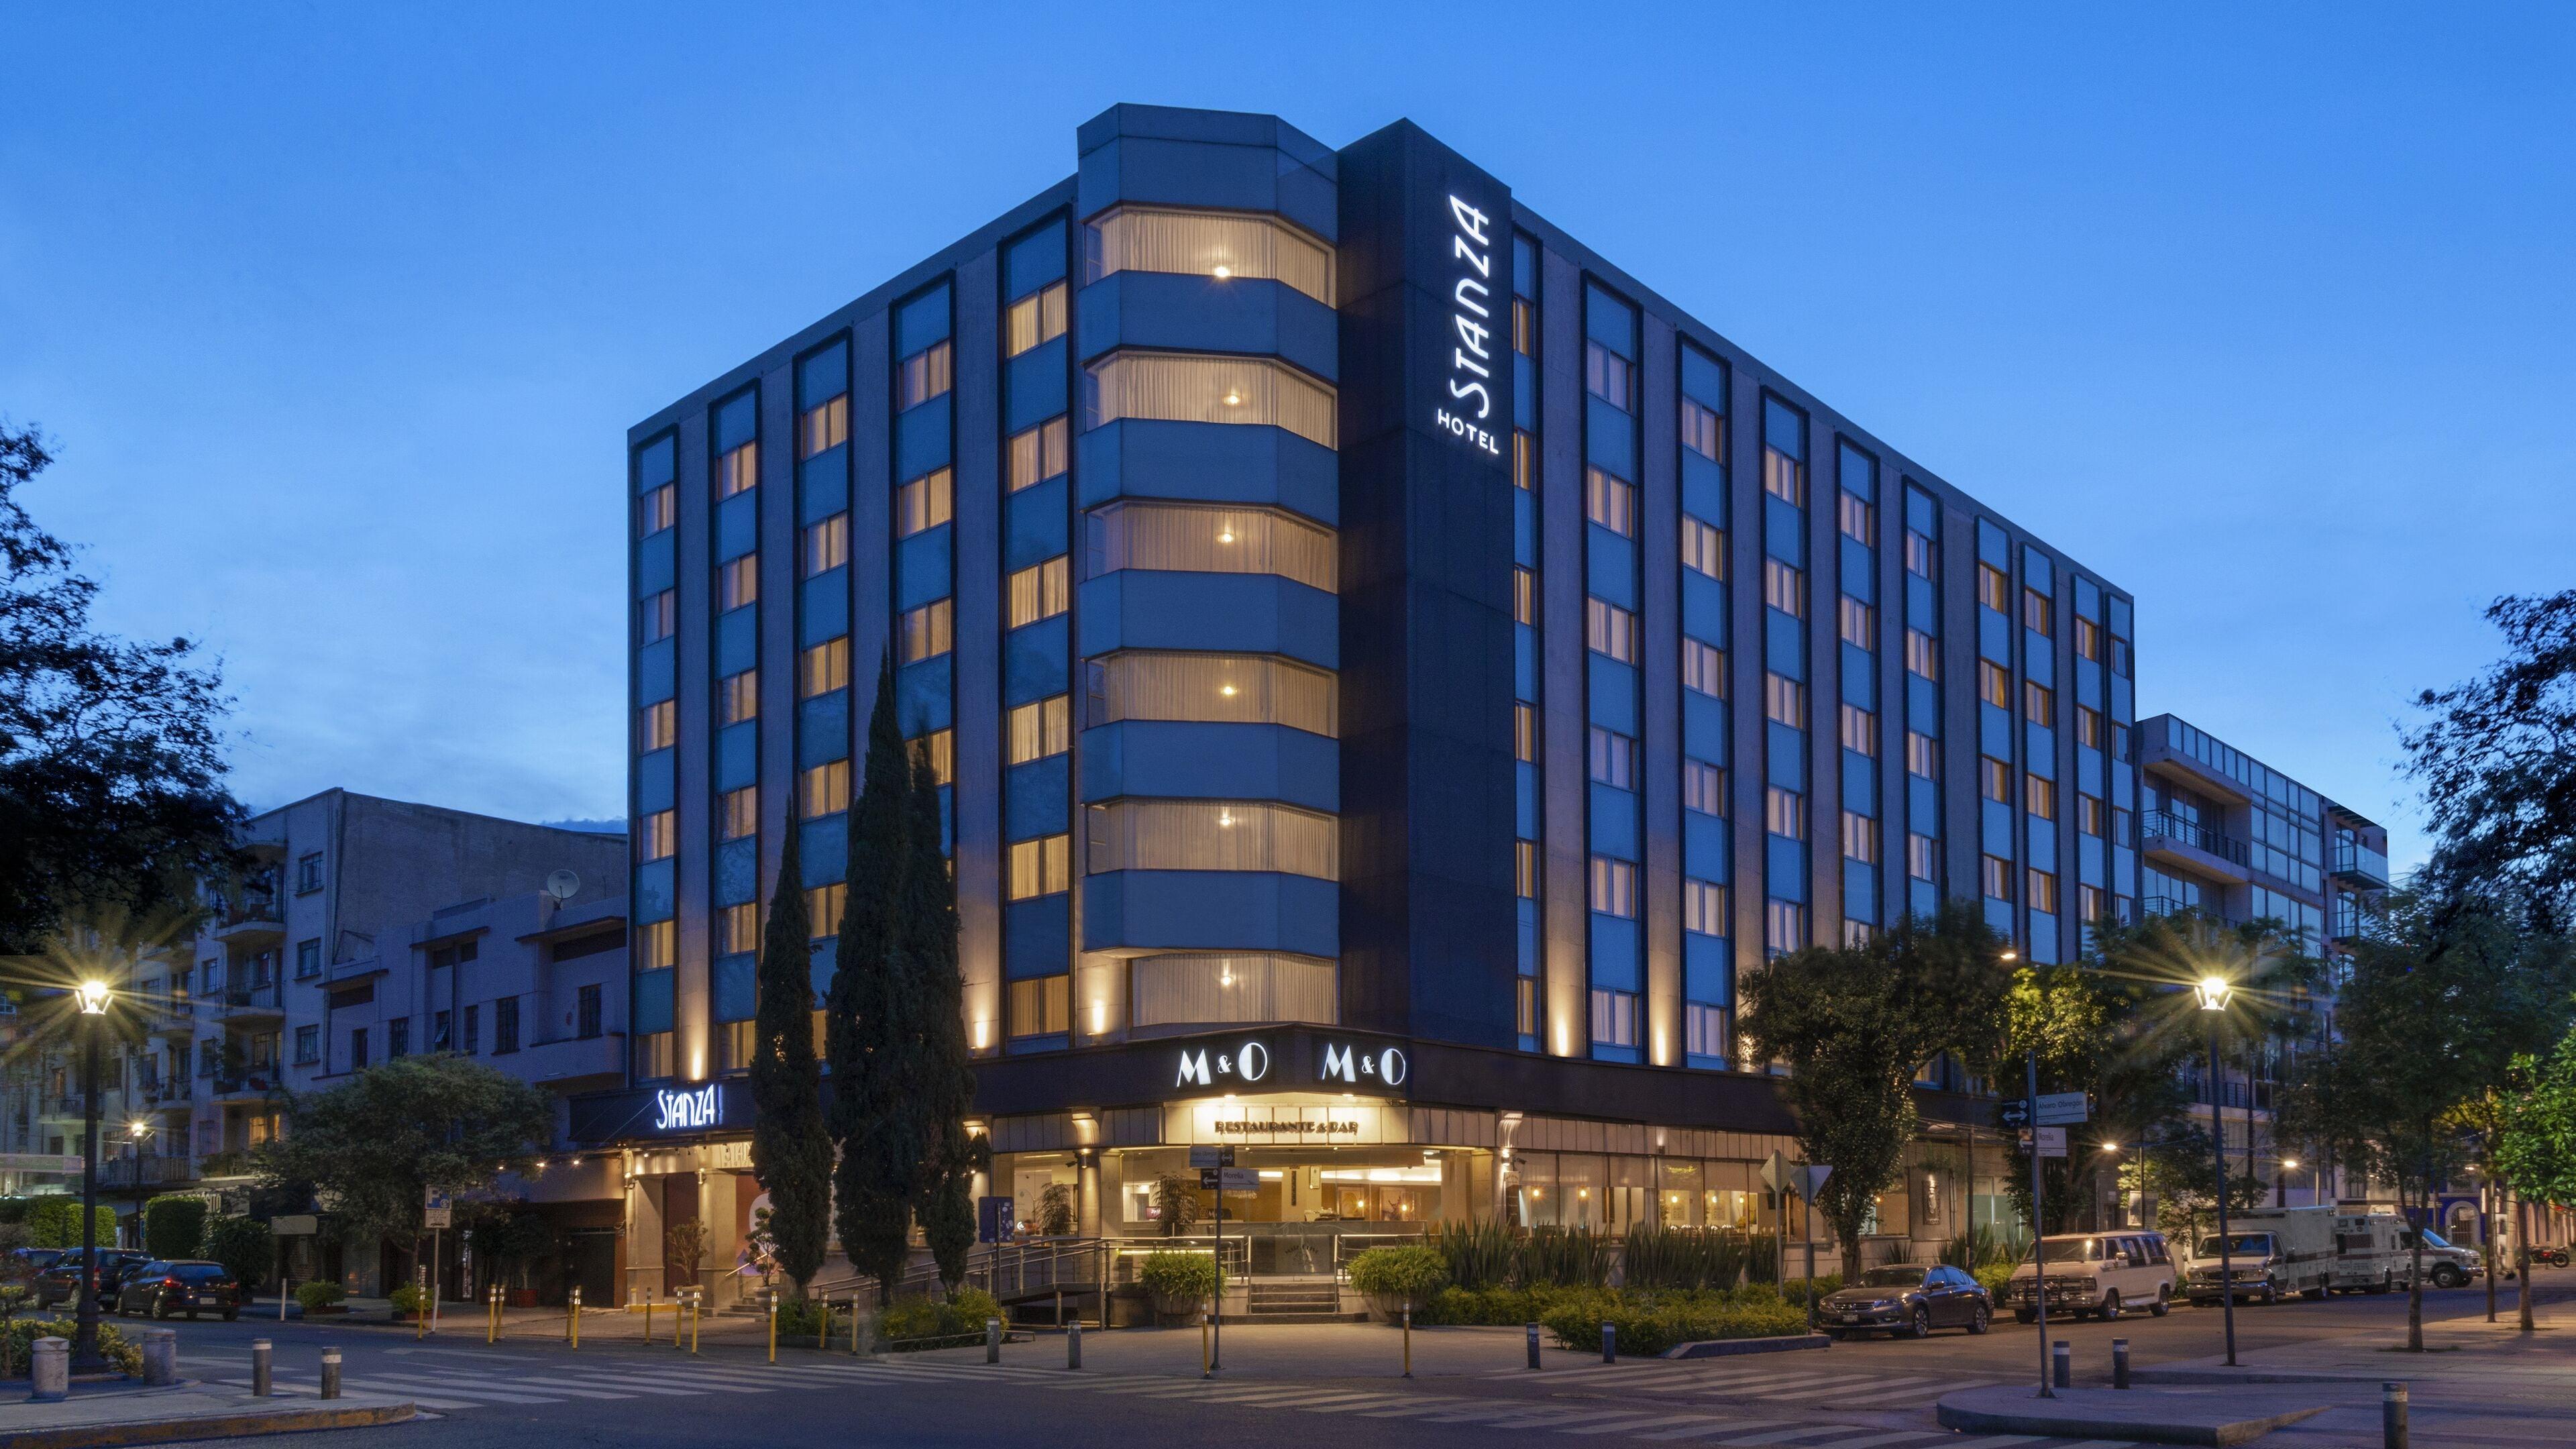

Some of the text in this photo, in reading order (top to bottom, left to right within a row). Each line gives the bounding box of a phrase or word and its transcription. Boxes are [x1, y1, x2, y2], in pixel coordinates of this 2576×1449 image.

[1448, 194, 1490, 419] STANZA
[1437, 408, 1499, 455] HOTEL
[655, 1083, 715, 1130] STANZA
[1215, 1121, 1316, 1135] RESTAURANTE
[1328, 1121, 1358, 1135] BAR
